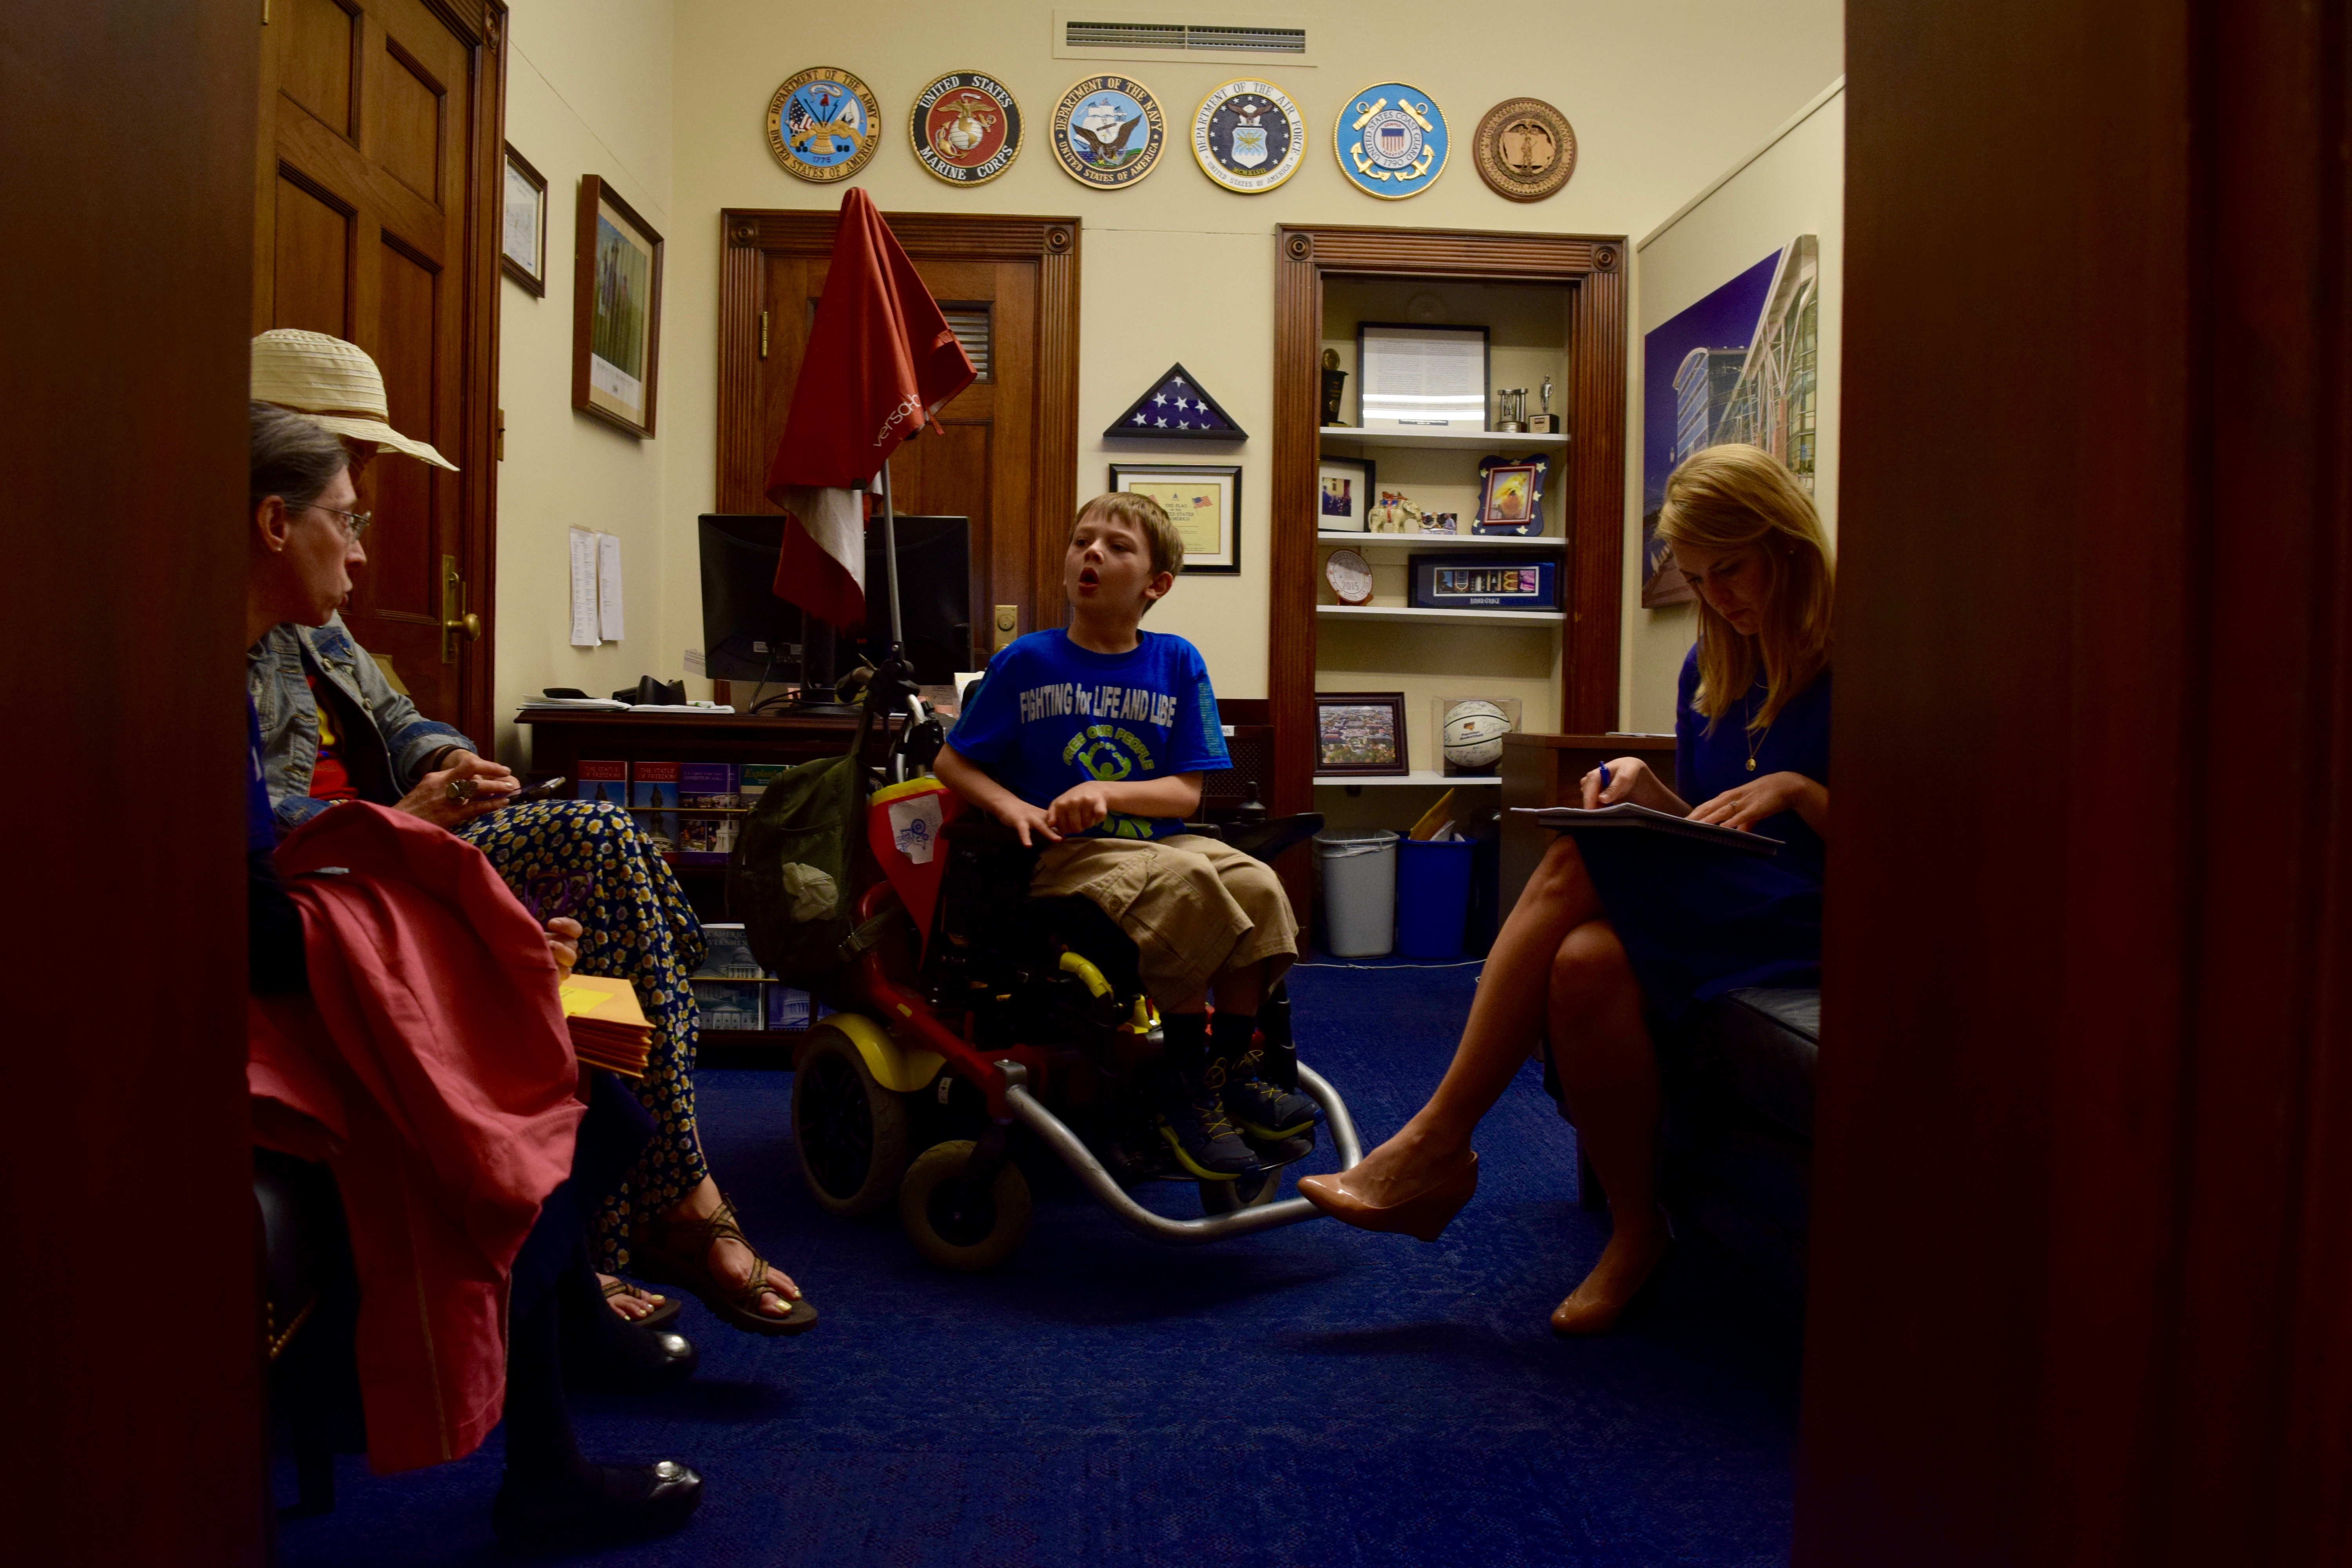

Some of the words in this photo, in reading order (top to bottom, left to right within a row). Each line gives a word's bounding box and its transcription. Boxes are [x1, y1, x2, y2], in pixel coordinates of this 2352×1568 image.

[771, 70, 818, 114] DEPARTMENT
[825, 70, 837, 79] OF
[843, 74, 860, 90] THE
[860, 93, 877, 118] ARMY
[919, 76, 959, 108] UNITED
[971, 76, 1013, 108] STATES
[1055, 78, 1103, 131] DEPARTMENT
[1107, 78, 1121, 89] OF
[1125, 82, 1147, 102] THE
[1143, 100, 1162, 132] NAVY
[1196, 89, 1227, 152] DEPARTMENT
[1233, 82, 1246, 93] OF
[1254, 82, 1274, 96] THE
[1276, 96, 1296, 115] AIR
[1292, 120, 1303, 155] FORCE
[1368, 112, 1393, 130] STATES
[1396, 113, 1418, 131] COAST
[1485, 120, 1499, 139] IOWA
[1497, 106, 1515, 120] ARMY
[1517, 105, 1554, 120] NATIONAL
[1553, 118, 1568, 143] GUARD
[770, 129, 790, 161] UNITED
[790, 160, 825, 177] STATES
[829, 167, 841, 176] OF
[846, 134, 876, 172] AMERICA
[920, 145, 966, 180] MARINE
[977, 145, 1013, 178] CORPS
[1059, 140, 1083, 171] UNITED
[1083, 169, 1114, 181] STATES
[1118, 172, 1128, 180] OF
[1131, 142, 1159, 176] AMERICA
[1365, 131, 1380, 161] UNITED
[1406, 133, 1421, 160] GUARD
[1208, 162, 1227, 180] UNITED
[1230, 178, 1253, 187] STATES
[1267, 164, 1291, 184] AMERICA
[1232, 167, 1267, 176] MCMXLVII
[1343, 582, 1359, 590] 2015
[1020, 682, 1073, 724] FIGHTING
[1075, 683, 1093, 715] for
[1093, 686, 1122, 718] LIFE
[1120, 688, 1149, 721] AND
[1149, 692, 1177, 728] LIBE
[1086, 724, 1114, 739] OUR
[1114, 728, 1155, 771] PEOPLE
